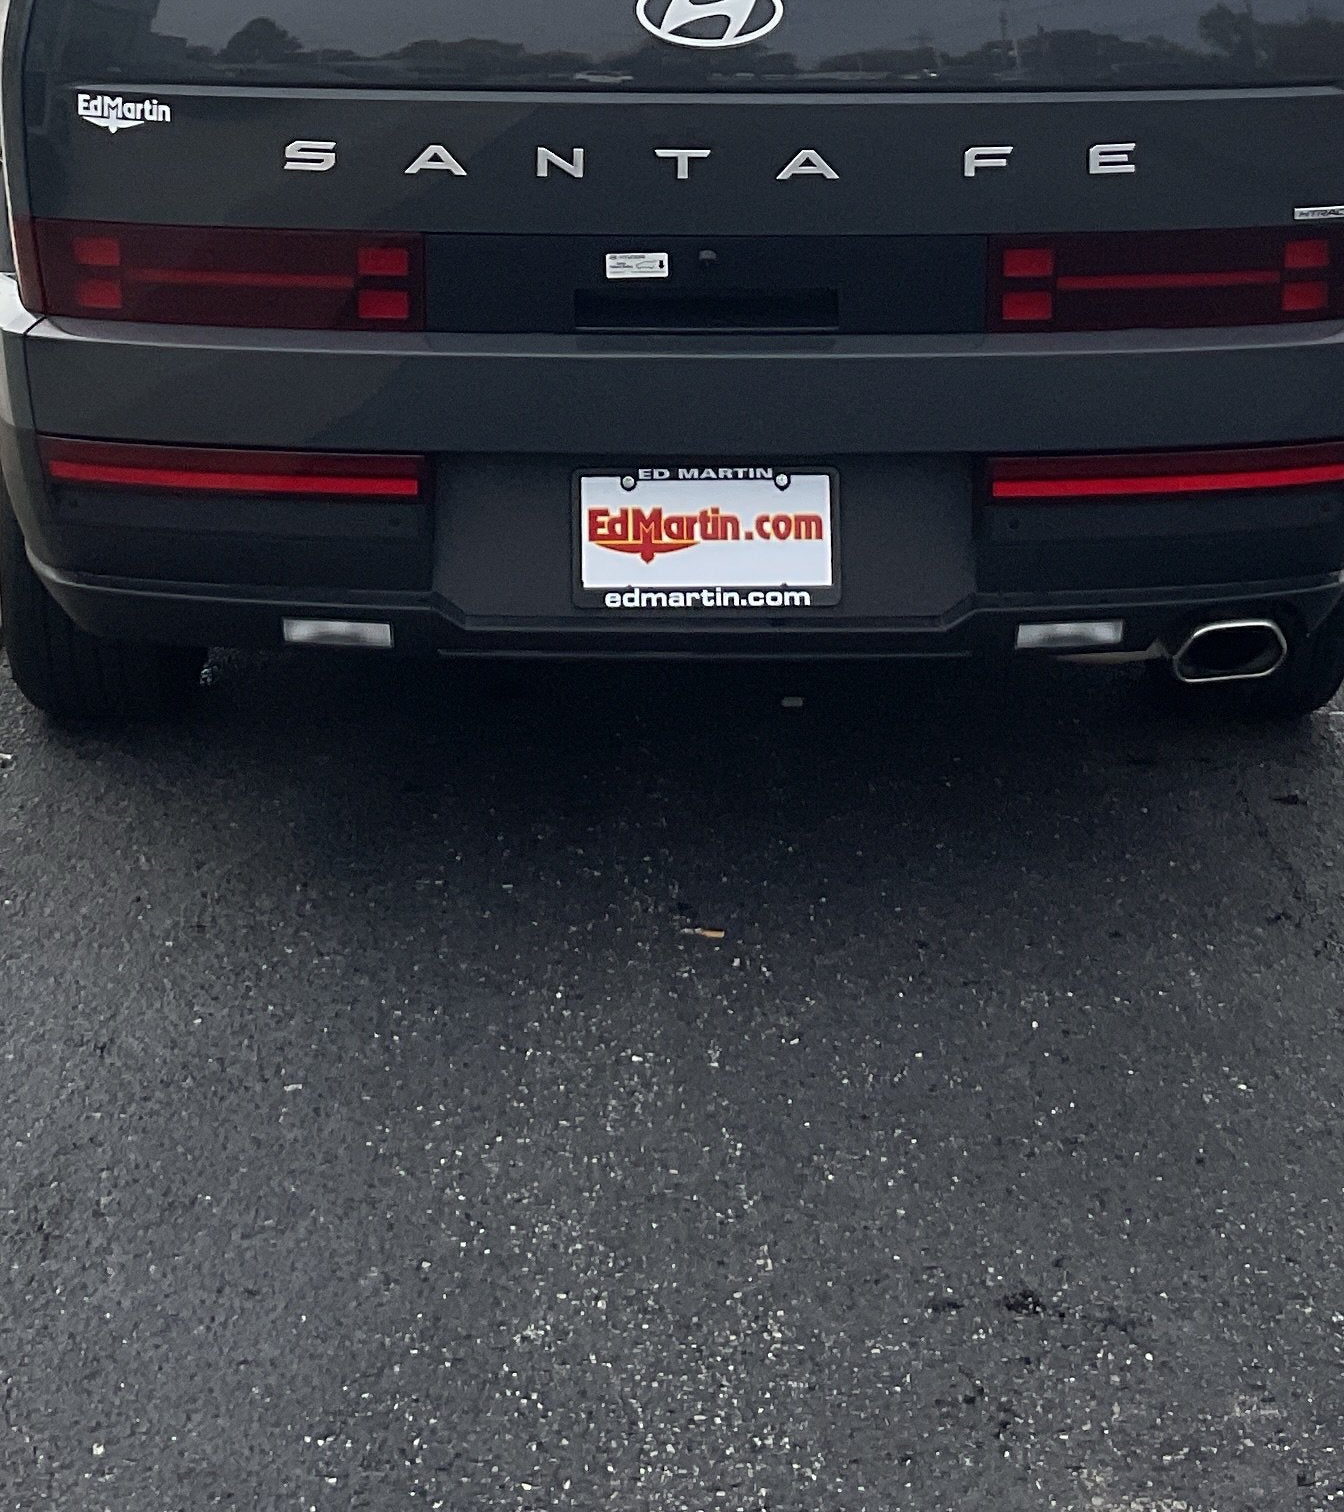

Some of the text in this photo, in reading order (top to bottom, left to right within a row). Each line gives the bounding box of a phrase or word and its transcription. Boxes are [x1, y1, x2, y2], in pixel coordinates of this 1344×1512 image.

[77, 93, 172, 123] EdMartin
[283, 139, 1138, 181] SANTA FE
[638, 467, 773, 480] ED MARTIN
[587, 505, 824, 542] EdMartin.com
[604, 587, 811, 608] edmartin.com
